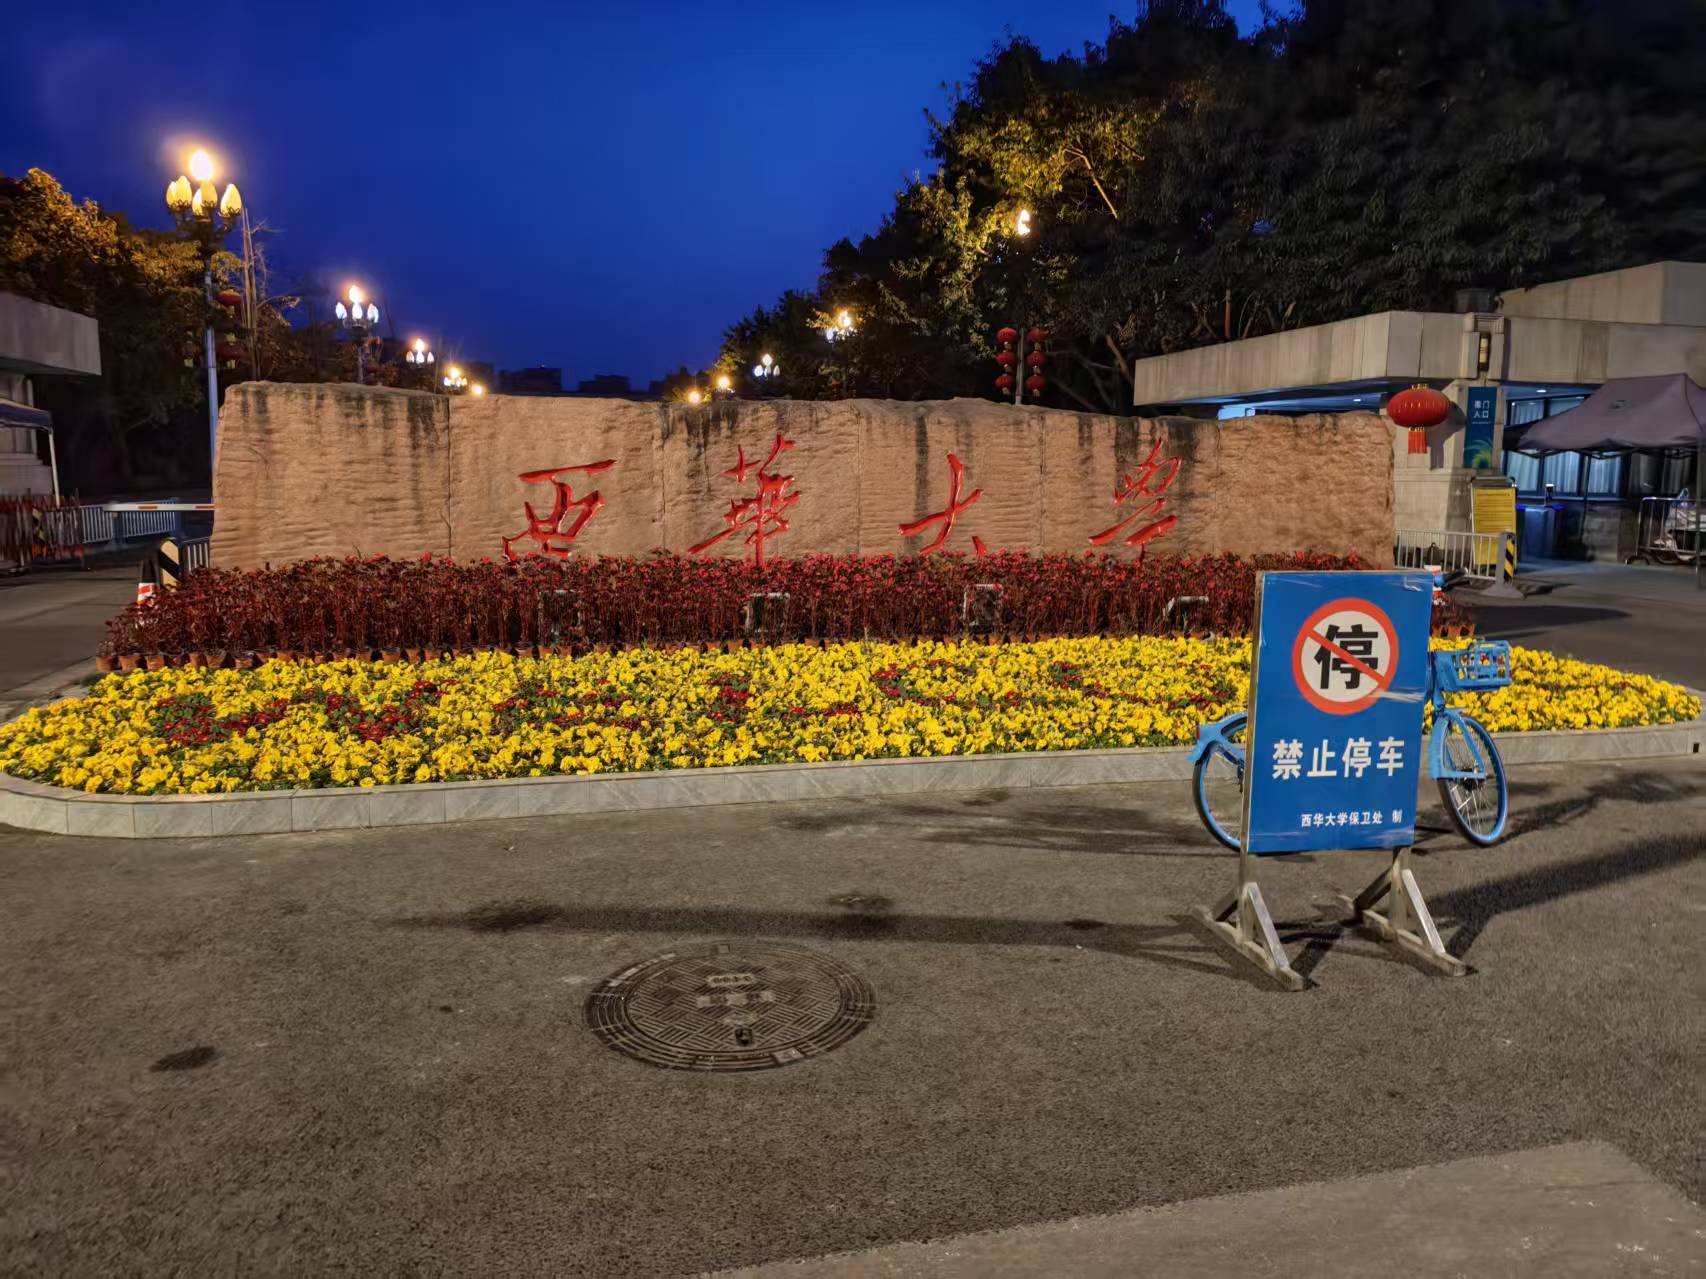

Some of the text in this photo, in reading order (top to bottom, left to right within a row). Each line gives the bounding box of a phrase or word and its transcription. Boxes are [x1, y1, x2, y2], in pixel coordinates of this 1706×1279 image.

[1314, 623, 1379, 690] 停
[1272, 737, 1405, 781] 禁止停车
[1301, 810, 1383, 828] 西华大学保卫处
